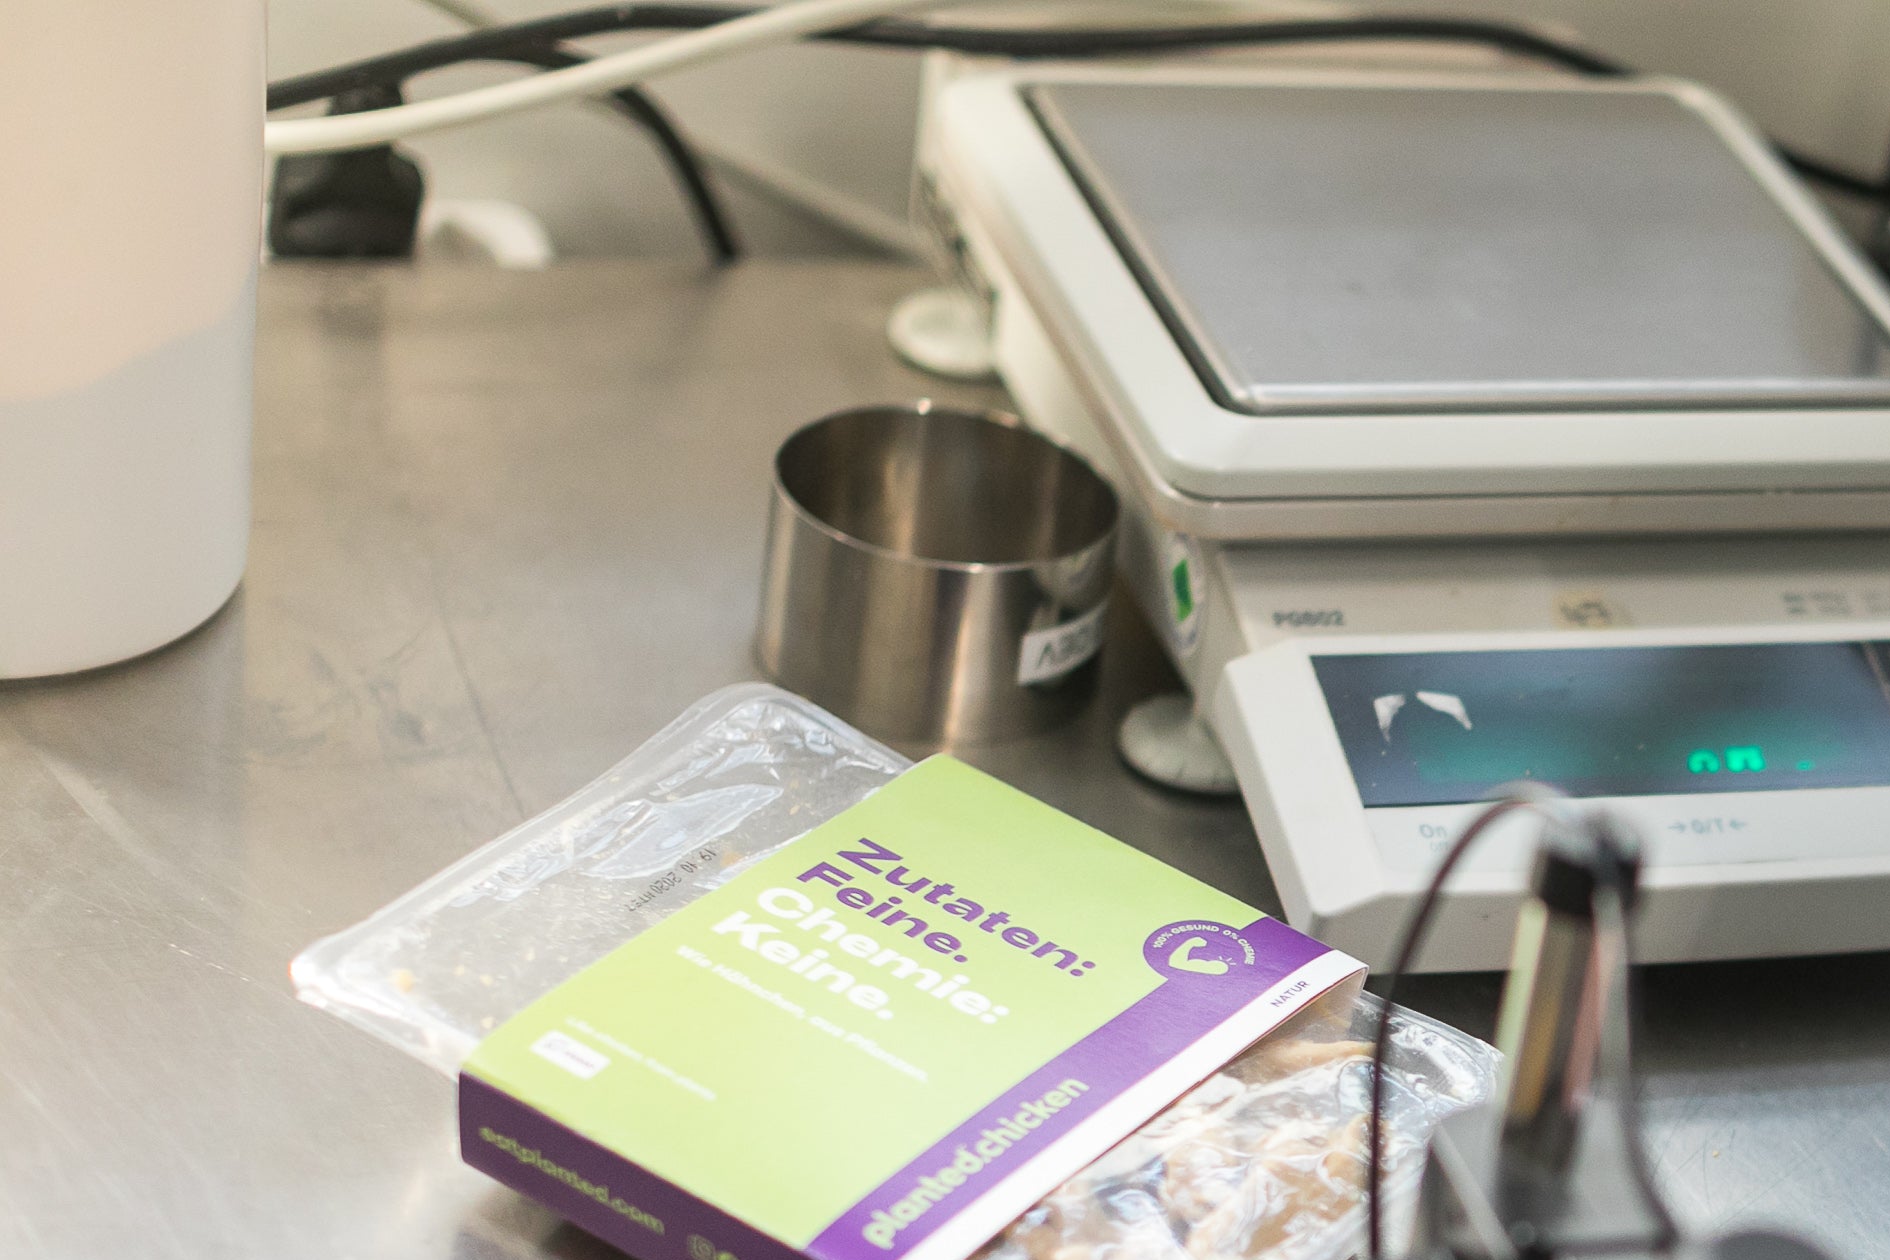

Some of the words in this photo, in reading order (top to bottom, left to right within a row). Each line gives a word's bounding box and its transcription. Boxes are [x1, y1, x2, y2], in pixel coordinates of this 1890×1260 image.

[757, 887, 1010, 1025] Chemie:
[796, 861, 968, 963] Feine.
[836, 837, 1096, 977] Zutaten:
[1153, 932, 1173, 948] 100%
[1171, 924, 1220, 934] GESUND
[1223, 930, 1239, 939] 0%
[1238, 938, 1256, 965] CHEMIE
[710, 911, 894, 1021] Keine.
[1270, 980, 1309, 1007] NATUR
[479, 1126, 666, 1236] eatplanted.com
[862, 1078, 1090, 1251] planted.chicken
